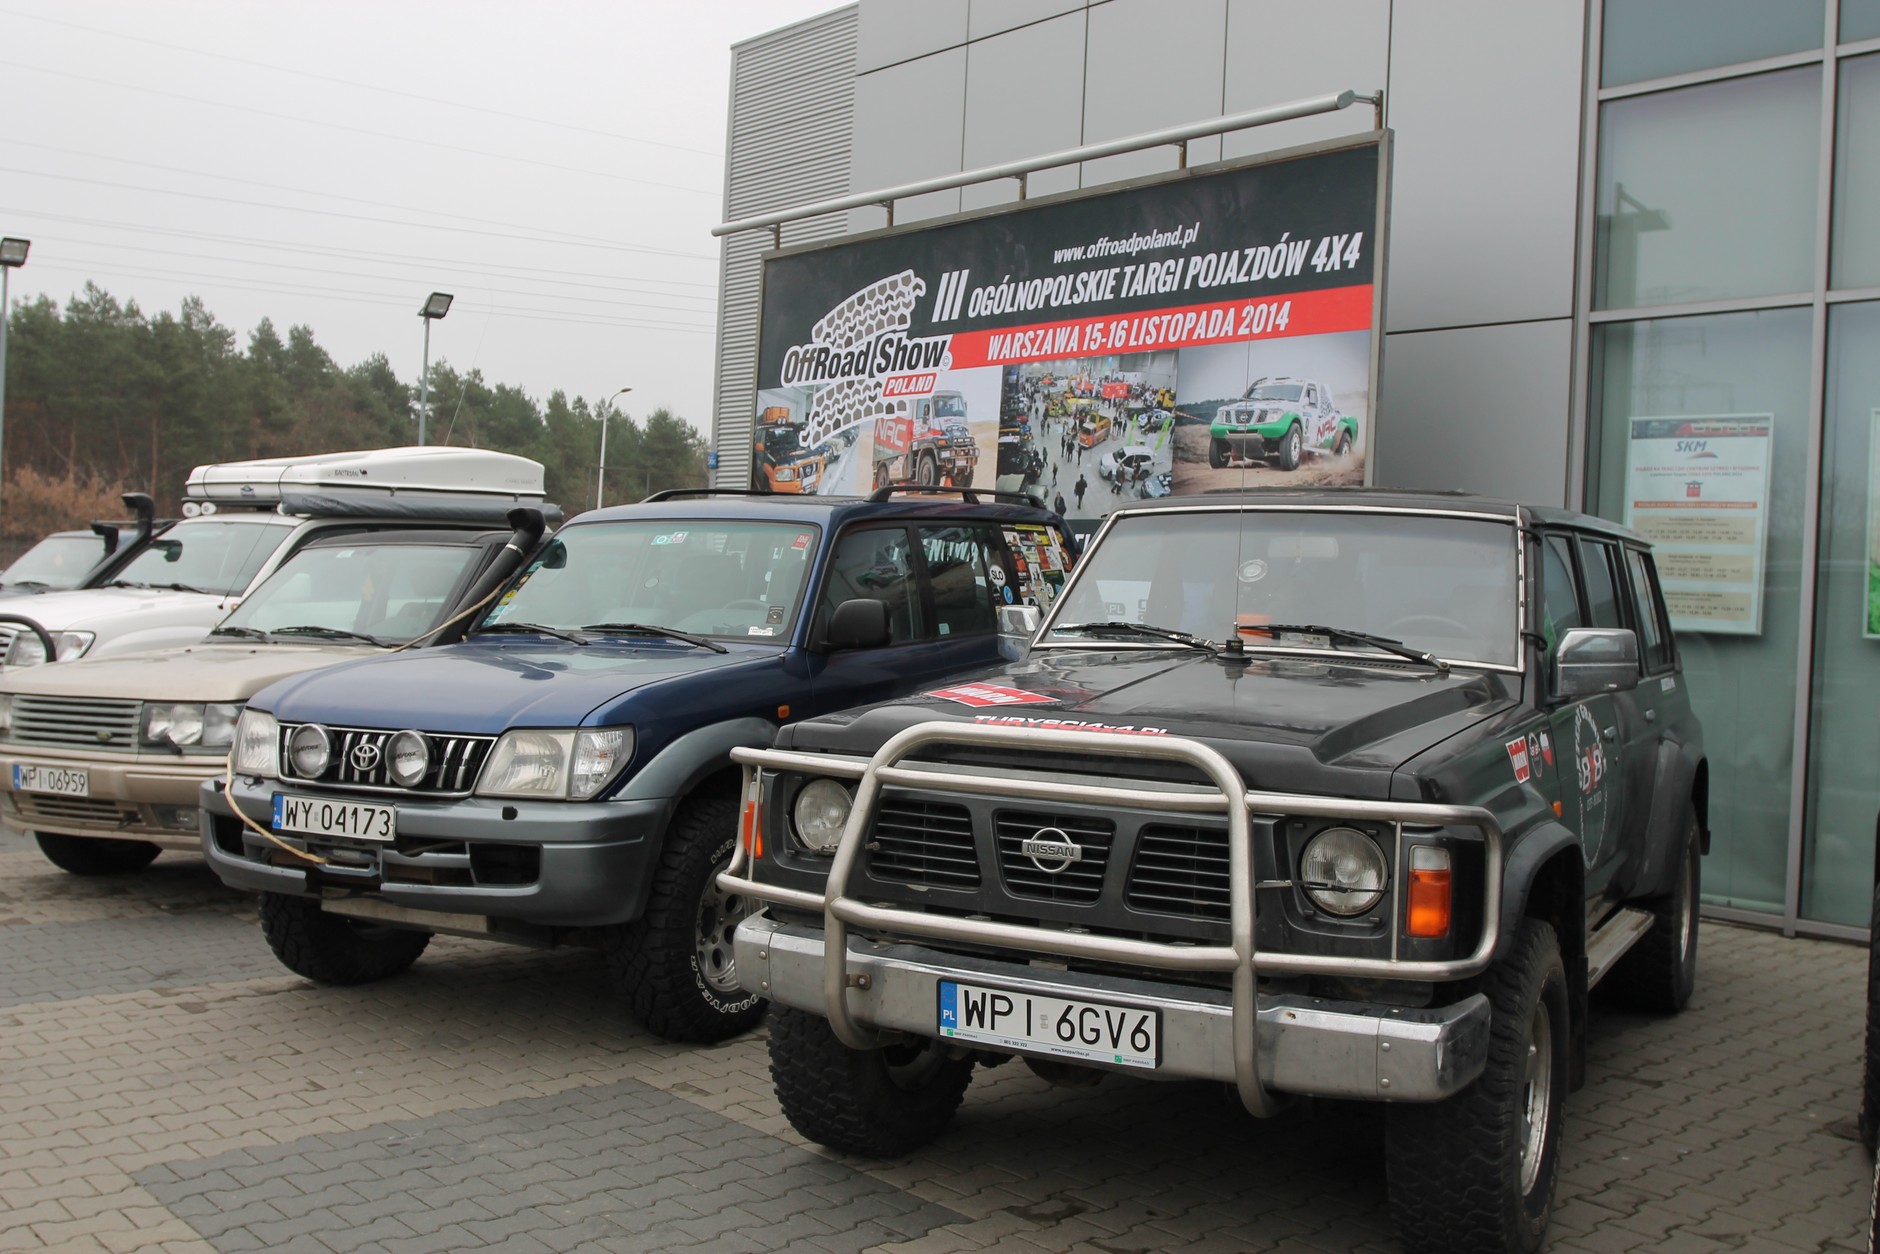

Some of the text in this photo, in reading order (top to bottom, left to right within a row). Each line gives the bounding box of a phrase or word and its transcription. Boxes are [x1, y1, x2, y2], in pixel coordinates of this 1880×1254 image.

[1053, 221, 1200, 263] www.offroadpoland.pl
[932, 232, 1363, 323] III OGÓLNOPOLSKIE TARGI POJAZDÓW 4X4
[987, 300, 1292, 361] WARSZAWA 15-16 LISTOPADA 2014
[783, 335, 947, 383] OffRoad Show
[885, 374, 935, 395] POLAND
[1675, 440, 1708, 452] SKM
[991, 569, 1004, 581] SLO
[48, 769, 86, 793] 06959
[286, 799, 391, 836] WY 04173
[1026, 843, 1075, 857] NISSAN
[943, 1009, 955, 1021] PL
[1056, 1005, 1151, 1053] 6GV6
